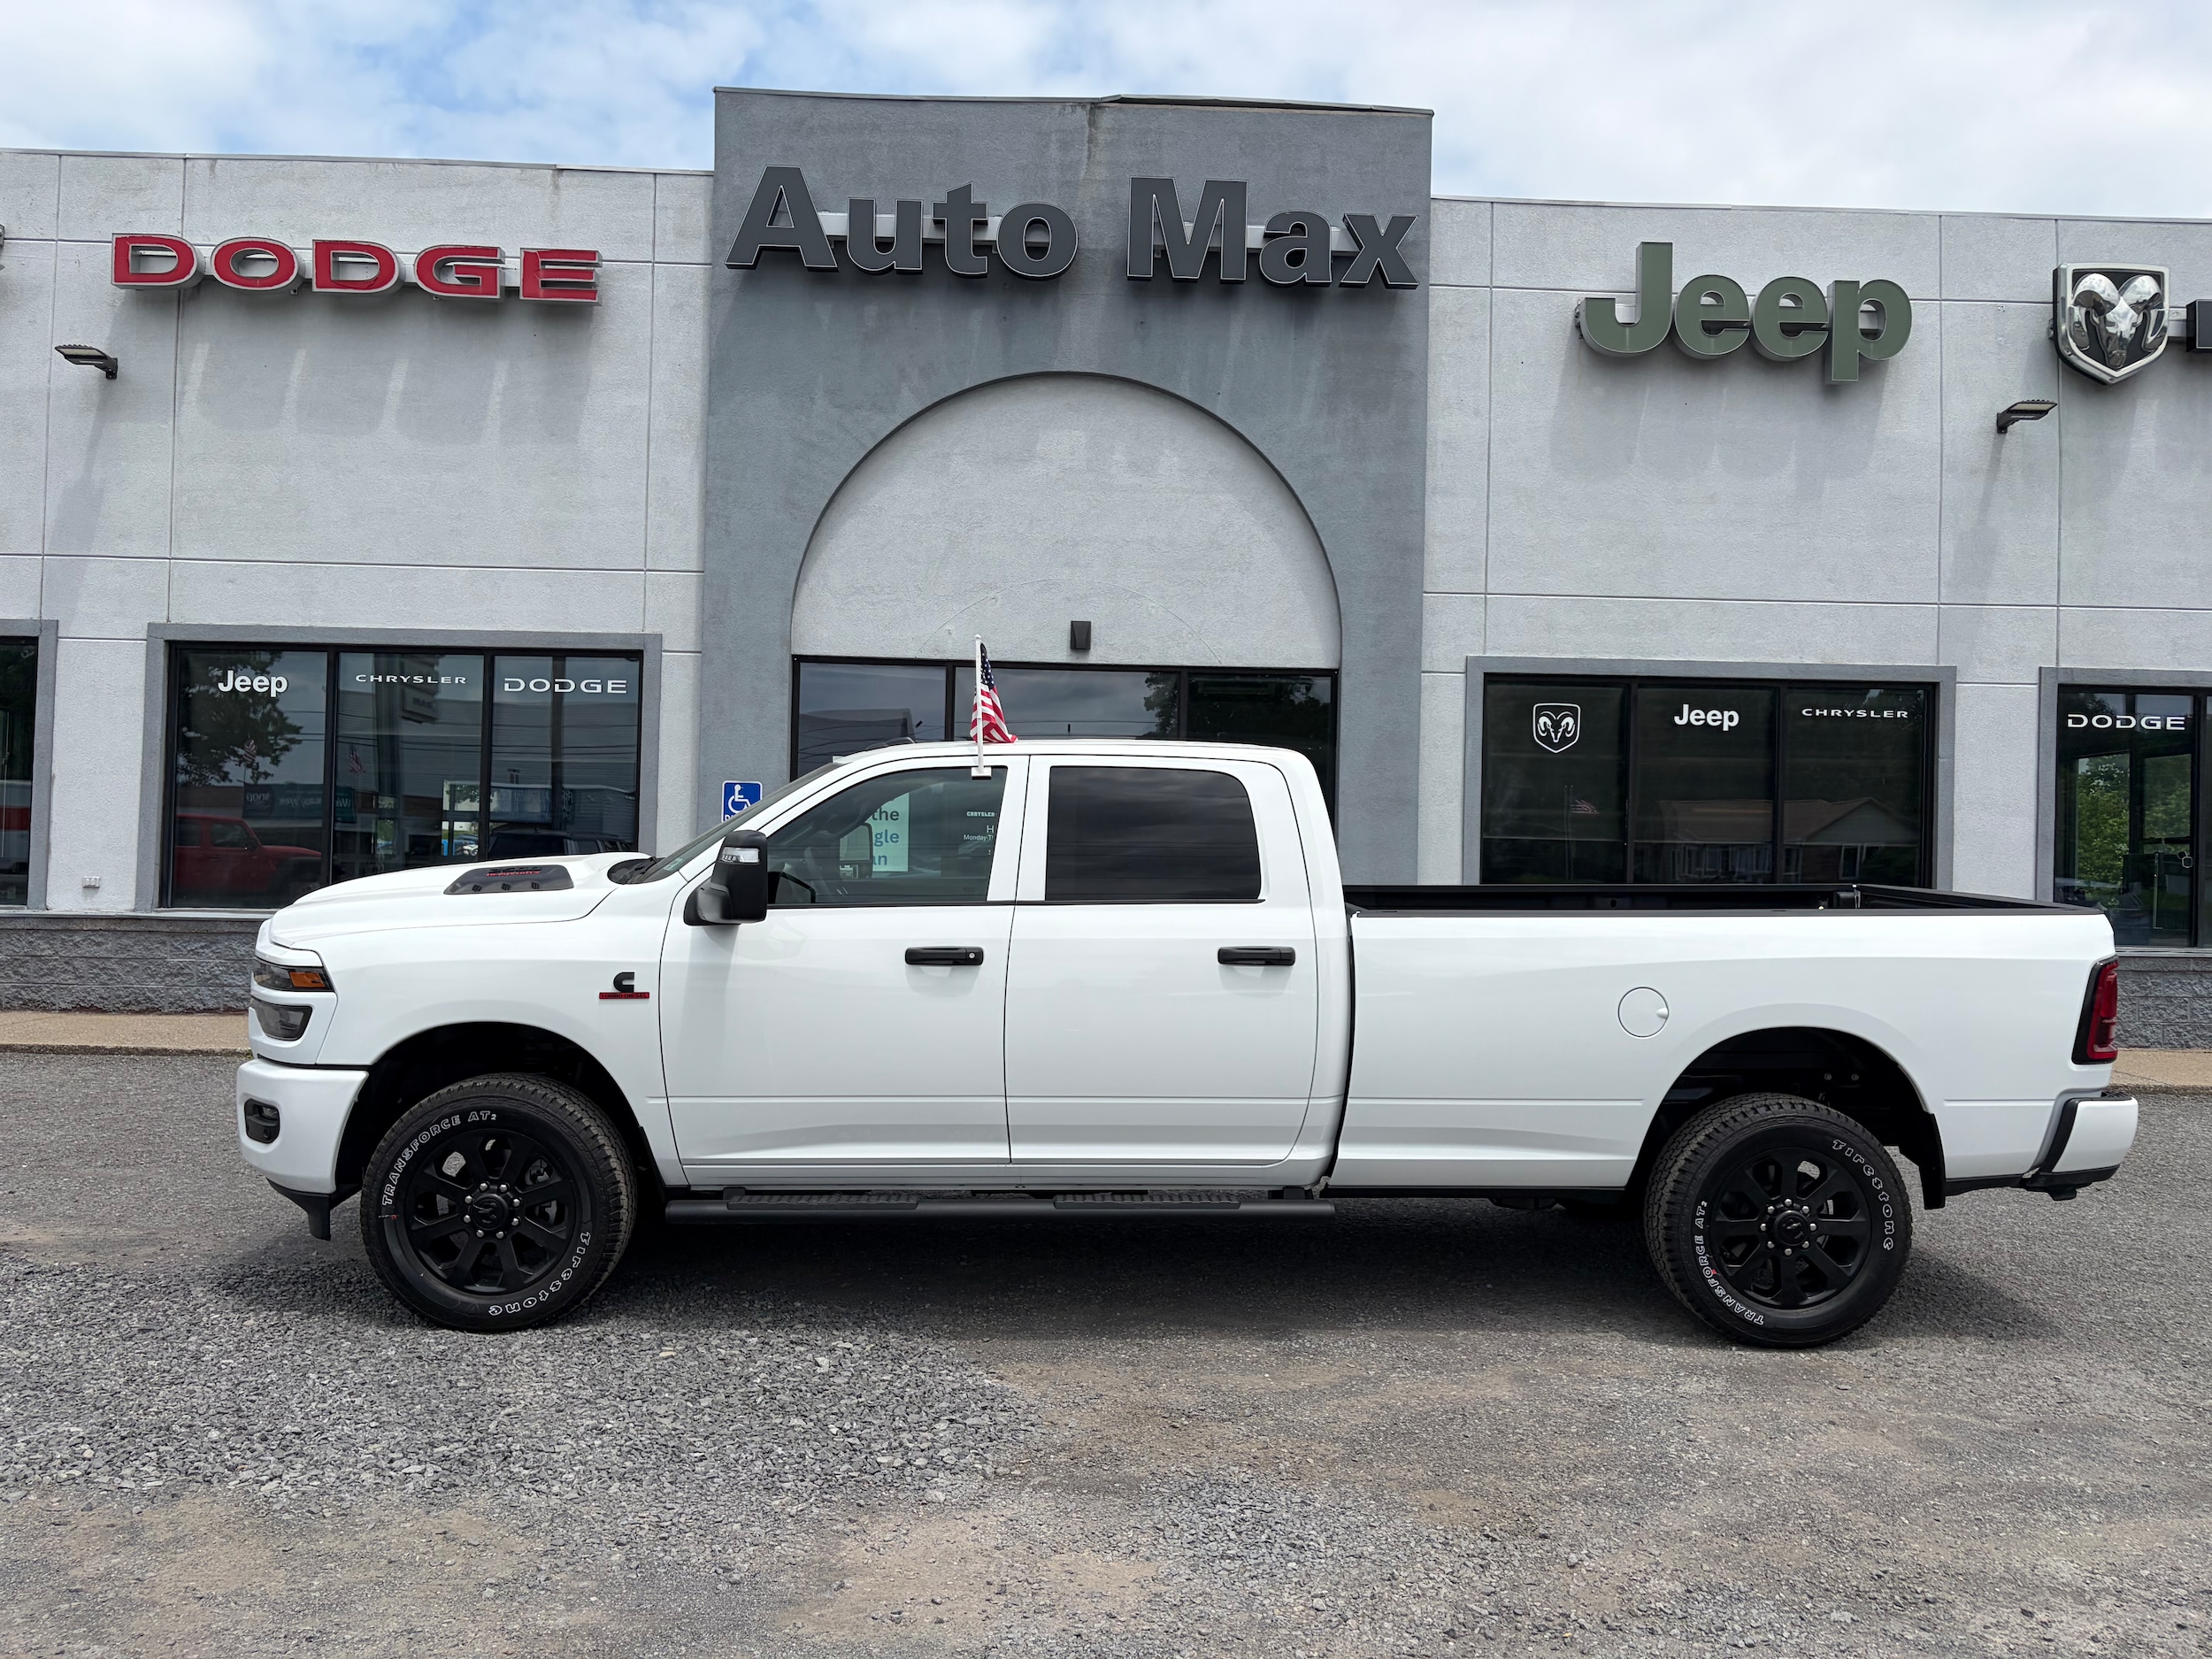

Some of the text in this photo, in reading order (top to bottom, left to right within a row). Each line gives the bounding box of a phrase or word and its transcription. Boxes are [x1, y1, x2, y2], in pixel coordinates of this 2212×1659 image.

[725, 165, 1418, 288] Auto Max
[112, 233, 602, 306] DODGE
[1579, 242, 1913, 384] Jeep
[218, 670, 288, 698] Jeep
[355, 674, 467, 685] CHRYSLER
[503, 678, 627, 695] DODGE
[1673, 703, 1740, 732] Jeep
[1801, 708, 1909, 719] CHRYSLER
[2067, 713, 2185, 731] DODGE
[381, 1115, 461, 1206] TRANSFORCE
[1694, 1234, 1764, 1325] TRANSFORCE
